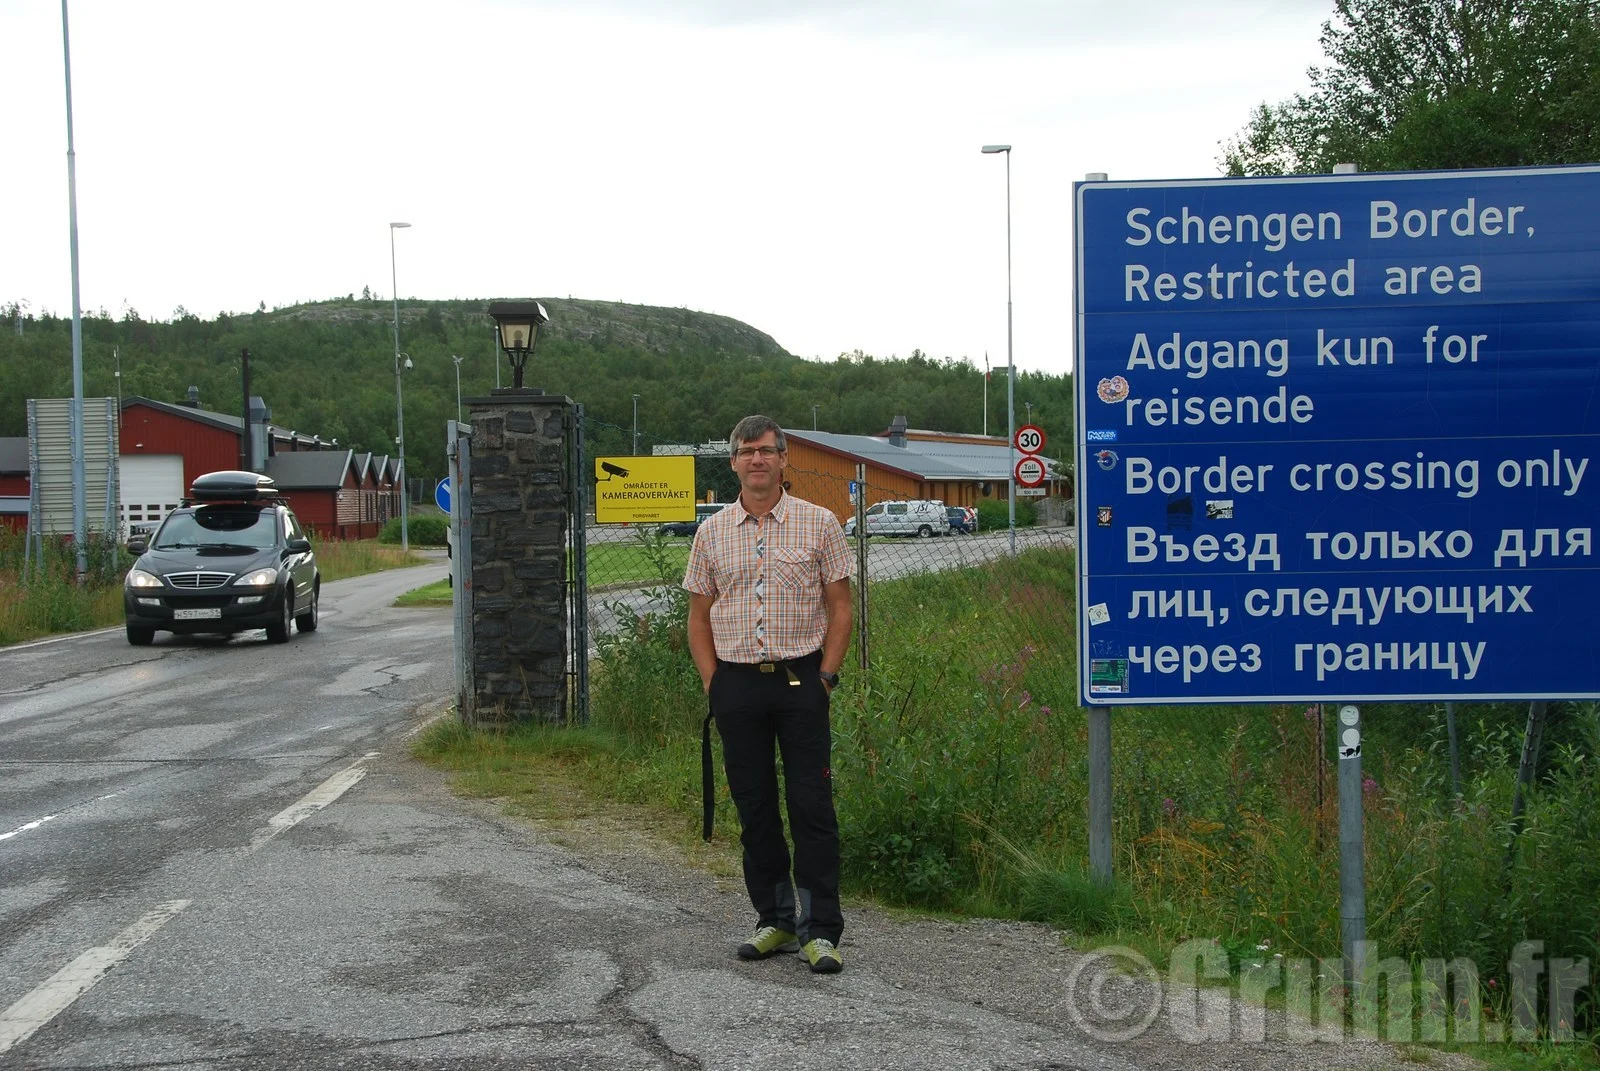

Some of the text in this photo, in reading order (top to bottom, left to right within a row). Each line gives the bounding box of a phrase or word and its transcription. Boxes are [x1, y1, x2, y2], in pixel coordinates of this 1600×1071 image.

[1126, 198, 1535, 251] Schengen Border,
[1125, 259, 1482, 301] Restricted area
[1126, 326, 1488, 378] Adgang kun for
[1126, 386, 1314, 426] reisende
[1020, 433, 1040, 447] 30
[602, 490, 690, 500] KAMERAOVERVÅKET
[623, 481, 658, 489] OMRÅDET
[1126, 450, 1589, 498] Border crossing only
[1127, 526, 1592, 572] Въезд только для
[1127, 586, 1533, 627] лиц, следующих
[1128, 645, 1263, 683] через
[1295, 641, 1487, 680] границу
